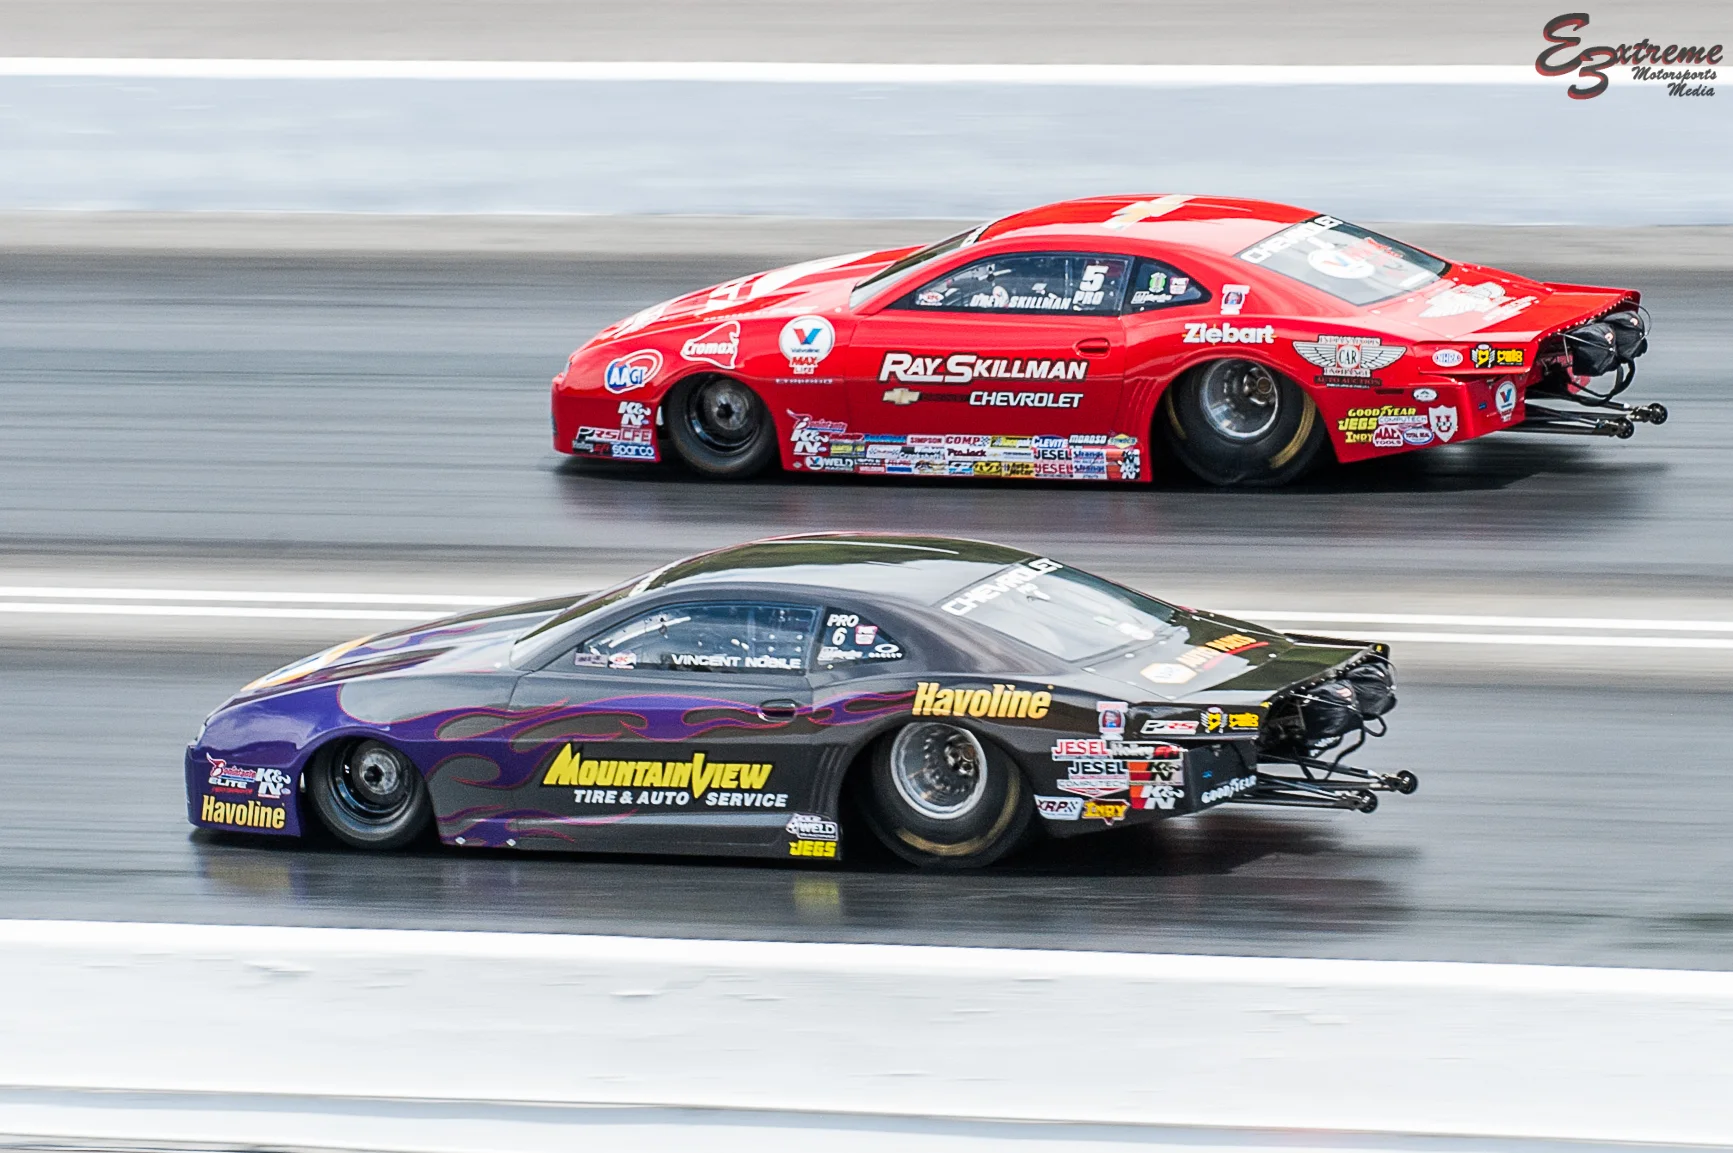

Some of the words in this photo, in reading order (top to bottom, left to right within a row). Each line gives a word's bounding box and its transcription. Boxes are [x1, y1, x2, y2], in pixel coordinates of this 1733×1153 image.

[1079, 265, 1109, 292] 5
[1008, 296, 1072, 309] SKILLMAN
[1073, 291, 1105, 305] PRO
[1183, 322, 1275, 344] Ziebart
[684, 341, 736, 356] Cromax
[792, 356, 817, 366] MAX
[1339, 349, 1358, 365] CAR
[879, 352, 943, 382] RAY
[944, 354, 1088, 383] SKILLMAN
[969, 391, 1084, 408] CHEVROLET
[1347, 405, 1416, 418] GOODYEAR
[1338, 418, 1378, 430] JEGS
[946, 436, 980, 445] COMP
[611, 444, 655, 456] sparco
[1033, 449, 1073, 461] JESEL
[824, 458, 853, 467] WELD
[1034, 463, 1074, 474] JESEL
[827, 613, 860, 628] PRO
[832, 627, 848, 646] 6
[671, 653, 741, 668] VINCENT
[744, 657, 802, 670] NOBILE
[911, 681, 1053, 719] Havoline
[1055, 741, 1109, 755] JESEL
[1070, 761, 1127, 775] JESEL
[208, 776, 248, 789] ELITE
[574, 789, 618, 804] TIRE
[619, 790, 634, 804] &
[636, 790, 690, 806] AUTO
[705, 792, 789, 807] SERVICE
[201, 795, 286, 829] Havoline
[1037, 800, 1069, 812] XRP
[1083, 801, 1128, 818] INDY
[799, 821, 836, 834] WELD
[788, 840, 837, 857] JEGS
